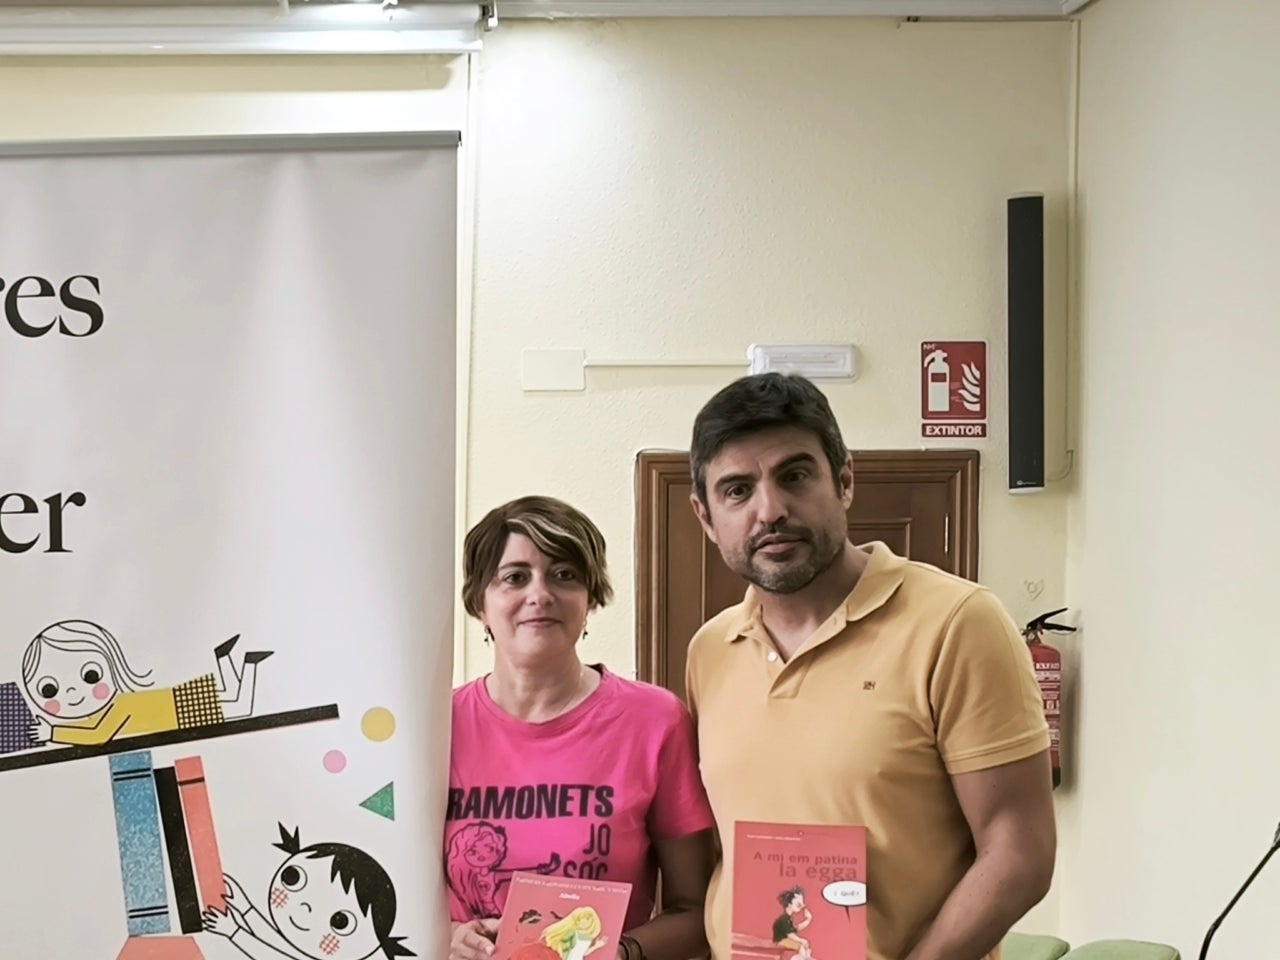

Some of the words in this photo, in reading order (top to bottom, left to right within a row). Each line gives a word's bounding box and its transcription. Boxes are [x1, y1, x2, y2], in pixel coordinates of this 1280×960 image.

[925, 425, 982, 436] EXTINTOR
[448, 783, 615, 821] RAMONETS
[583, 823, 612, 857] JO
[753, 851, 763, 861] A
[789, 854, 810, 864] em
[815, 854, 858, 866] patina
[779, 863, 797, 878] la
[805, 865, 858, 882] egga
